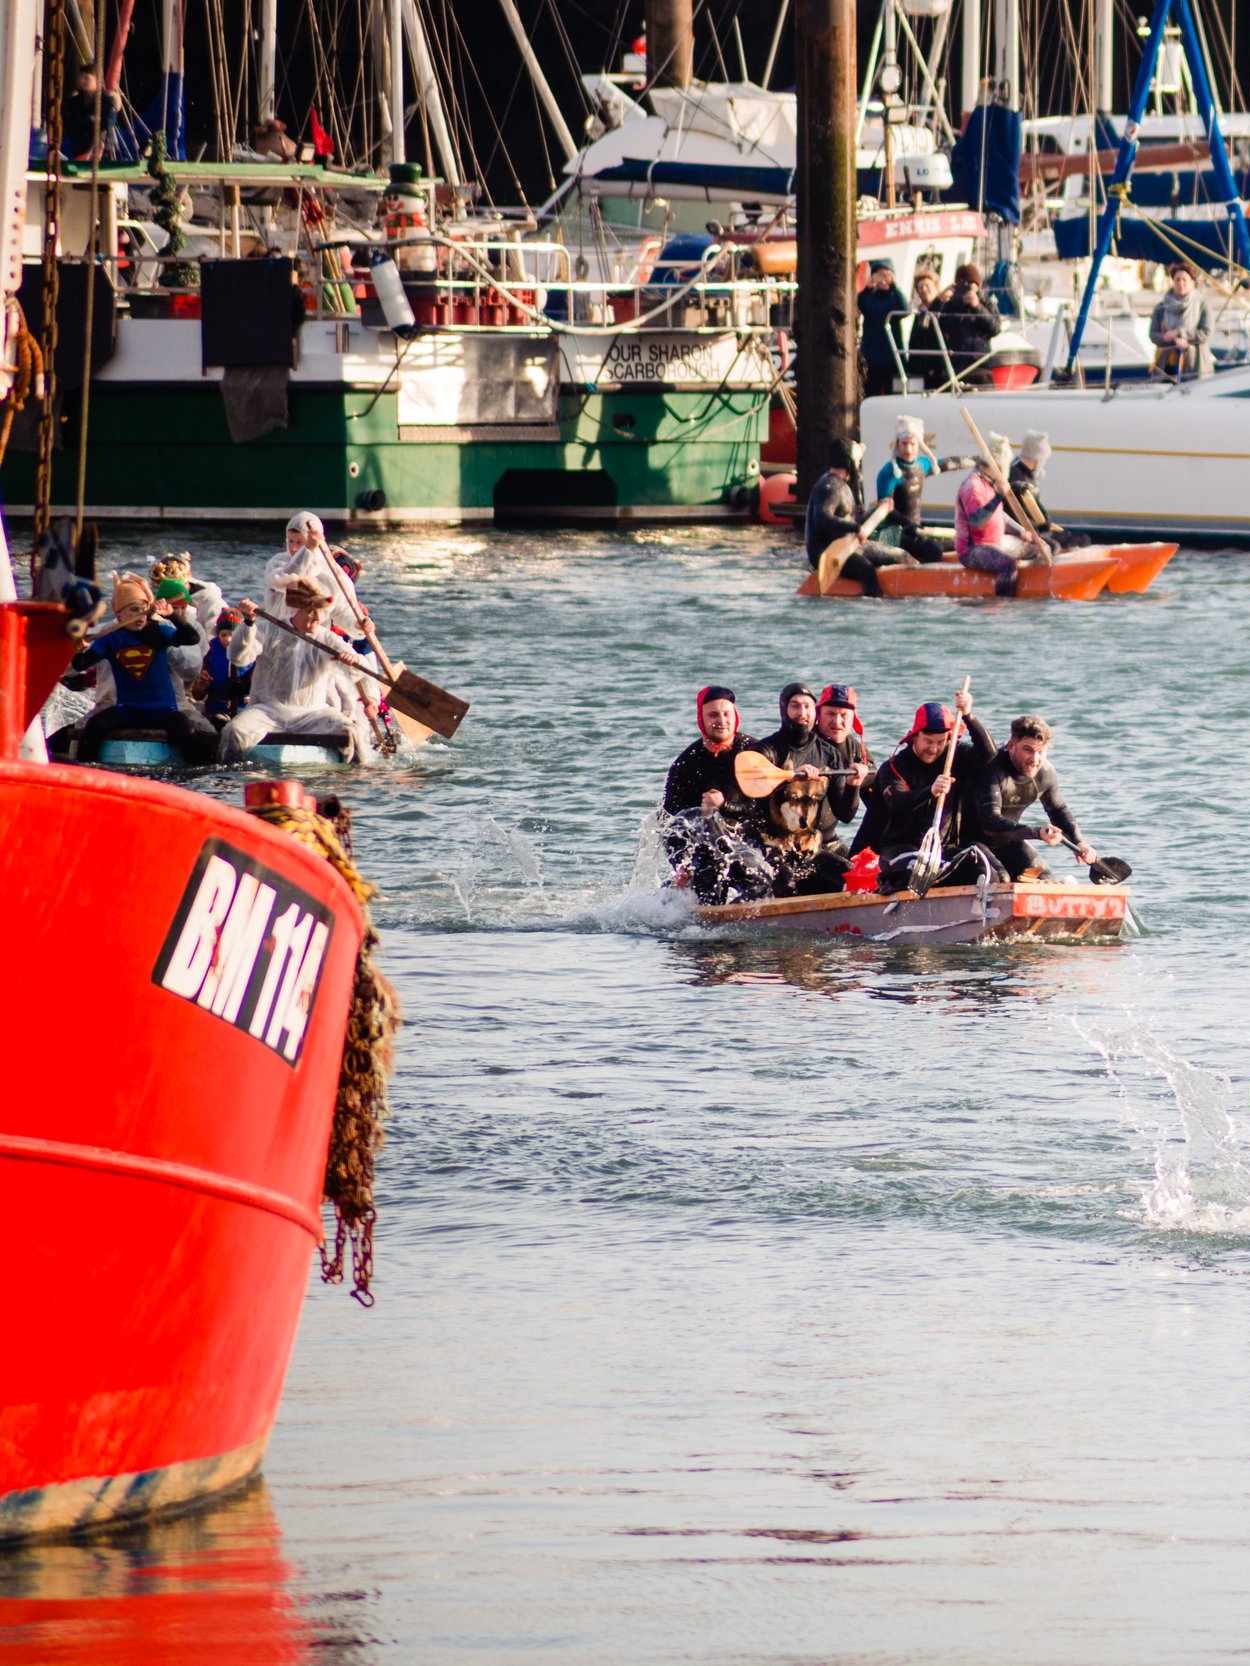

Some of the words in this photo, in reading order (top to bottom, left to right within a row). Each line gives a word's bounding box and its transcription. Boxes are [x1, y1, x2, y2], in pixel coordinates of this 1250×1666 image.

[610, 344, 641, 362] OUR
[649, 343, 713, 362] SHARON
[605, 362, 720, 380] SCARBOROUGH
[161, 854, 278, 1024] BM
[248, 902, 330, 1062] 114
